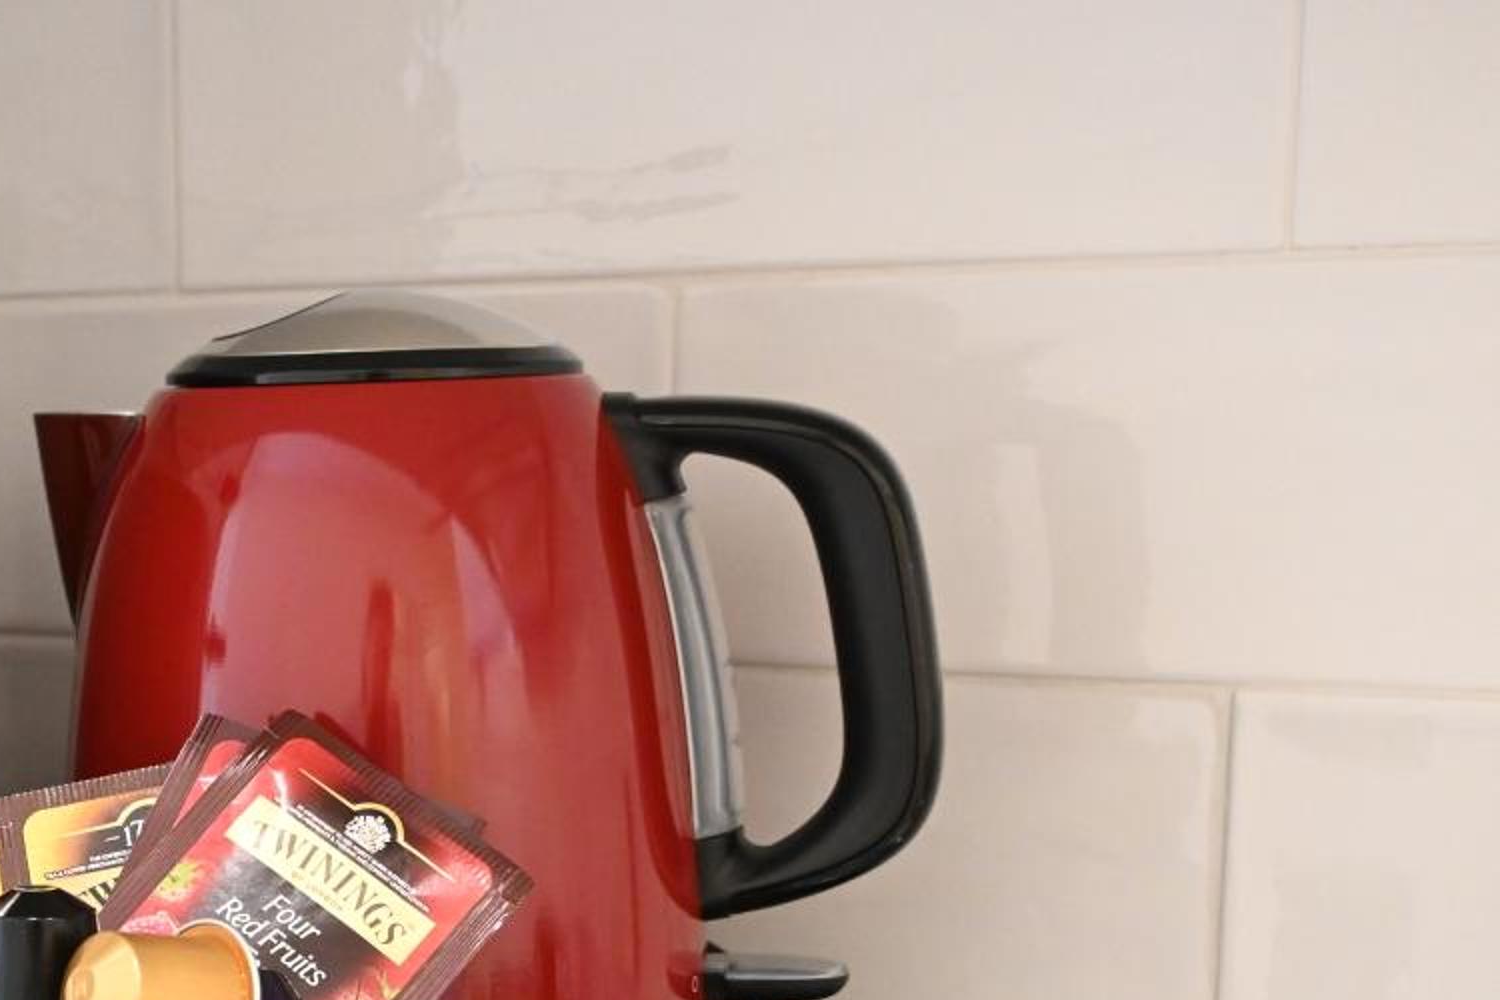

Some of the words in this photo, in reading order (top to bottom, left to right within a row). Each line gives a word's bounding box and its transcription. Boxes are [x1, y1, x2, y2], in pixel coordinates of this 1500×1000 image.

[252, 819, 406, 946] TWININGS
[261, 893, 322, 940] Four
[215, 896, 271, 939] Red
[257, 928, 327, 987] Fruits
